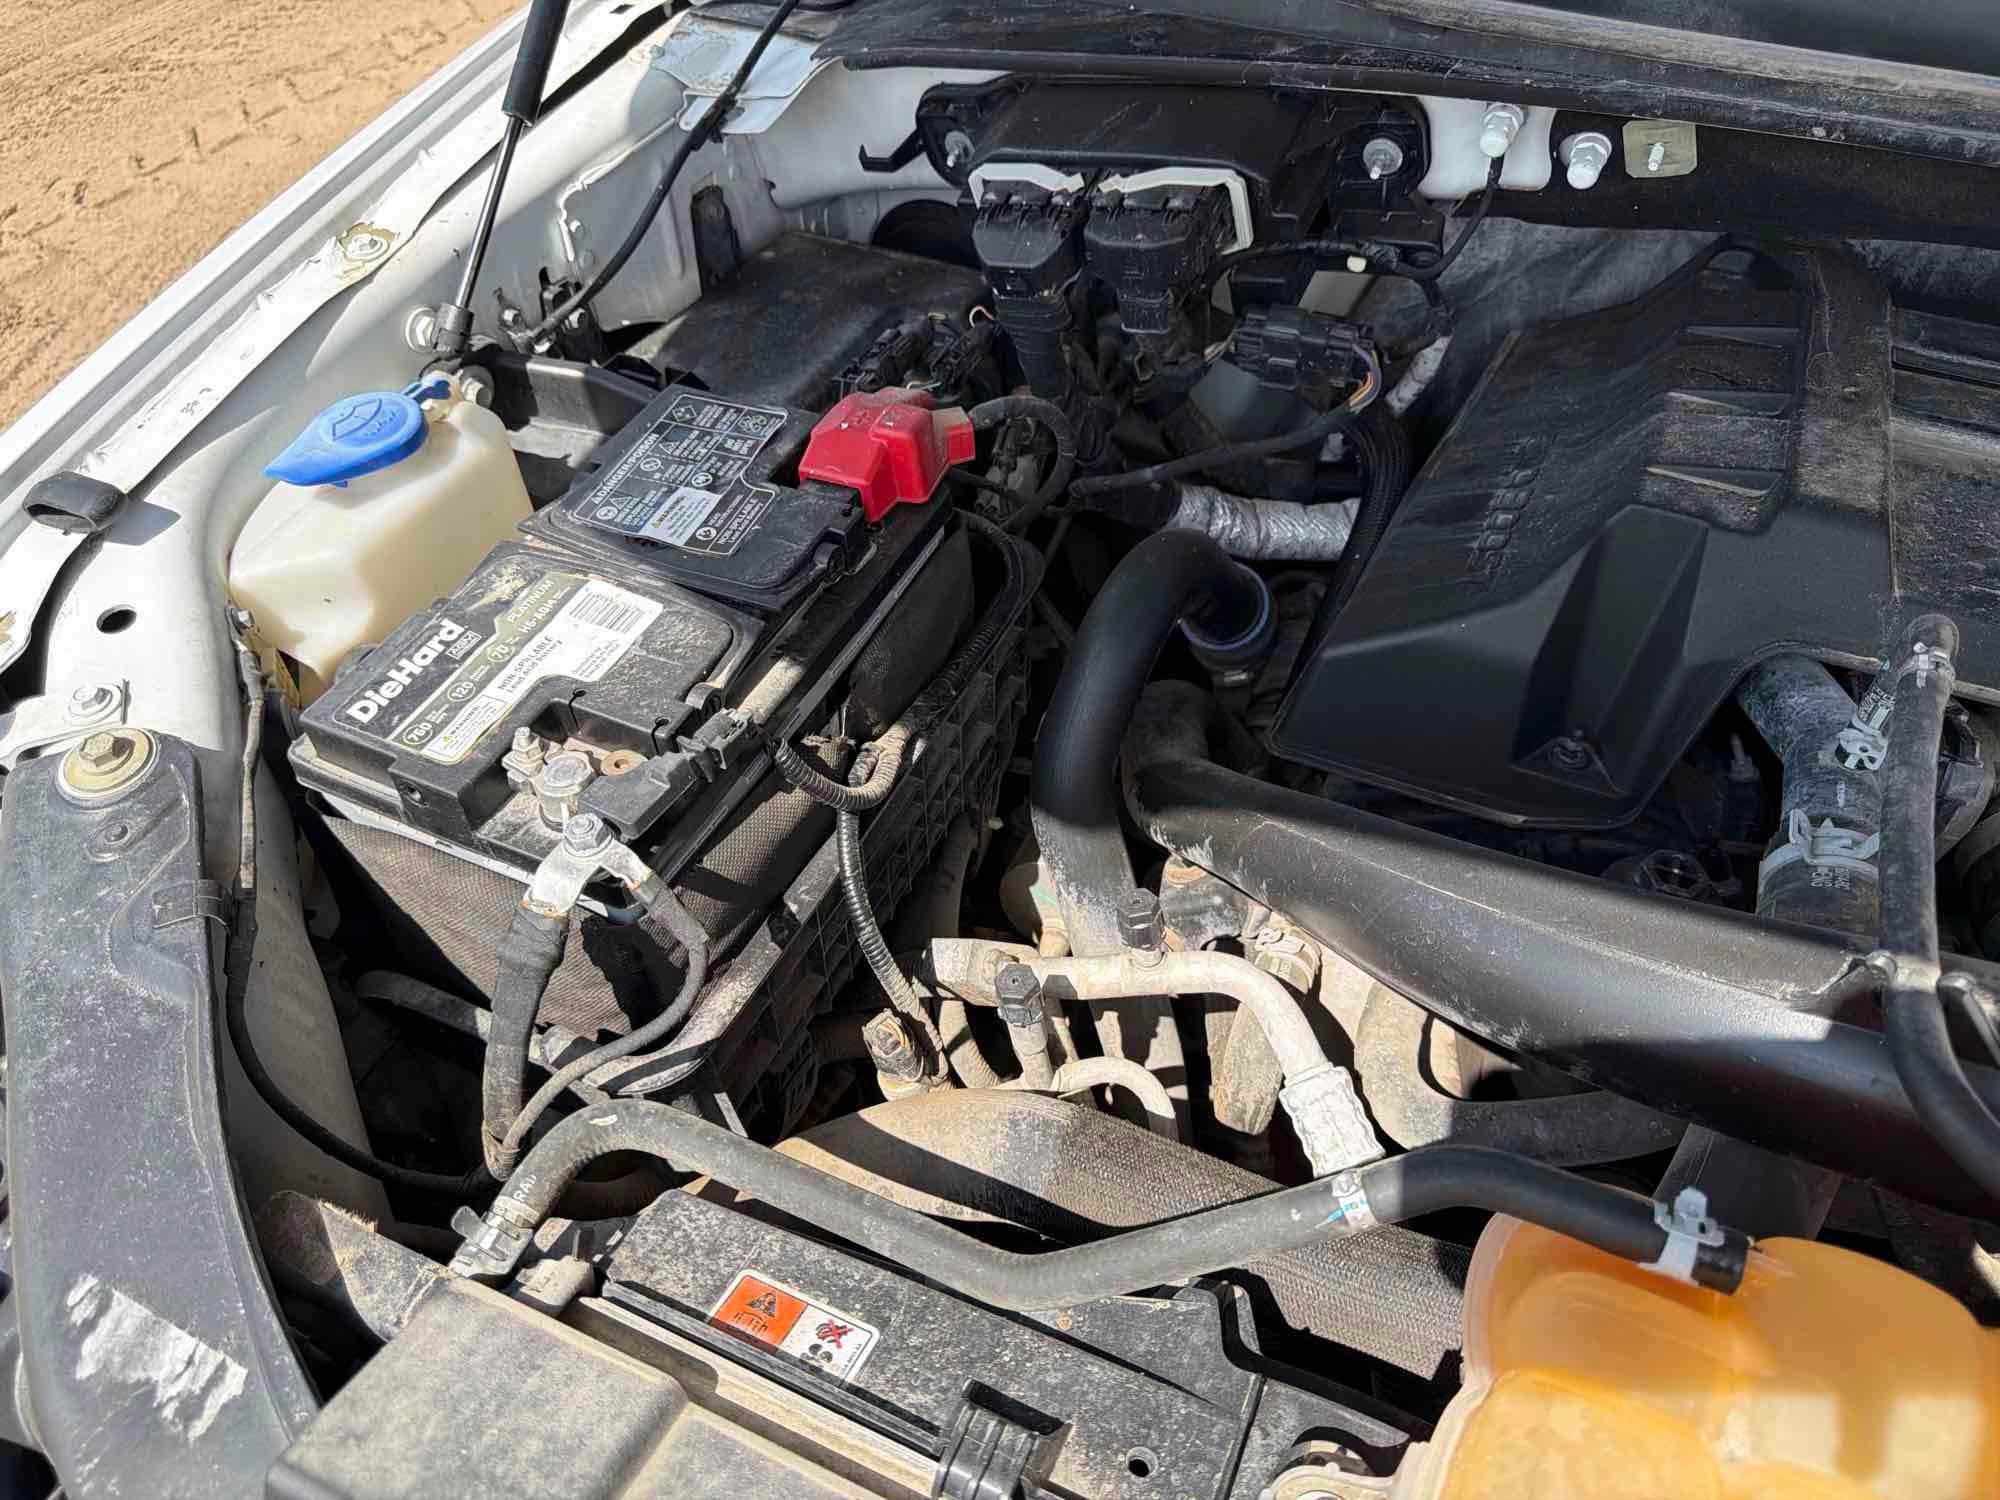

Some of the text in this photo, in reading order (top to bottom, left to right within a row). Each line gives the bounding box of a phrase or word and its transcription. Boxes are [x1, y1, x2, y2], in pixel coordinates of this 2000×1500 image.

[507, 579, 555, 623] PLATINUM
[346, 618, 465, 724] DieHard
[451, 681, 474, 699] 120
